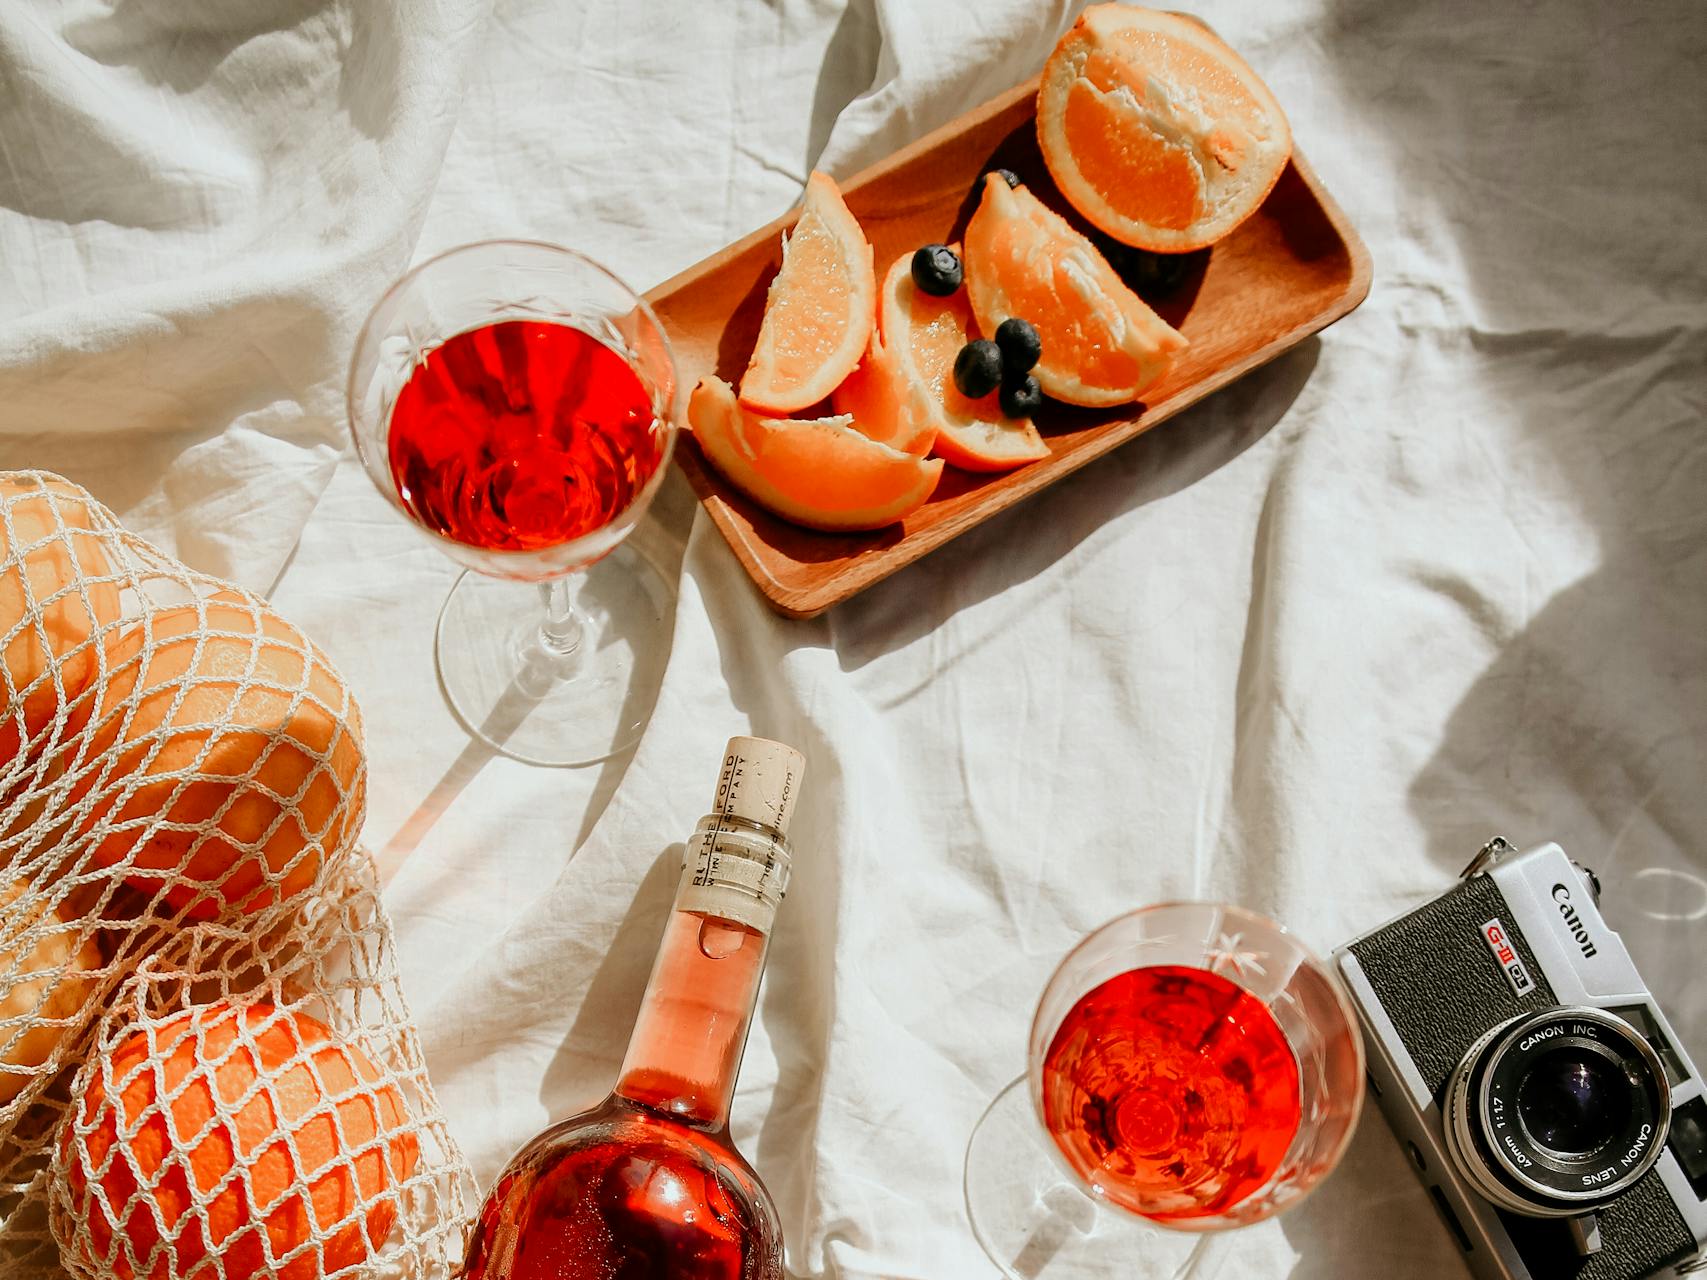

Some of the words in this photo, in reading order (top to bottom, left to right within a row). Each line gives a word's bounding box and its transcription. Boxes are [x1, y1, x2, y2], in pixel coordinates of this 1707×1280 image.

[1551, 883, 1598, 959] Canon
[1519, 1025, 1564, 1052] CANON
[1572, 1025, 1598, 1038] INC.
[1504, 1134, 1533, 1168] 40mm
[1620, 1123, 1652, 1168] CANON
[1581, 1166, 1618, 1186] LENS
